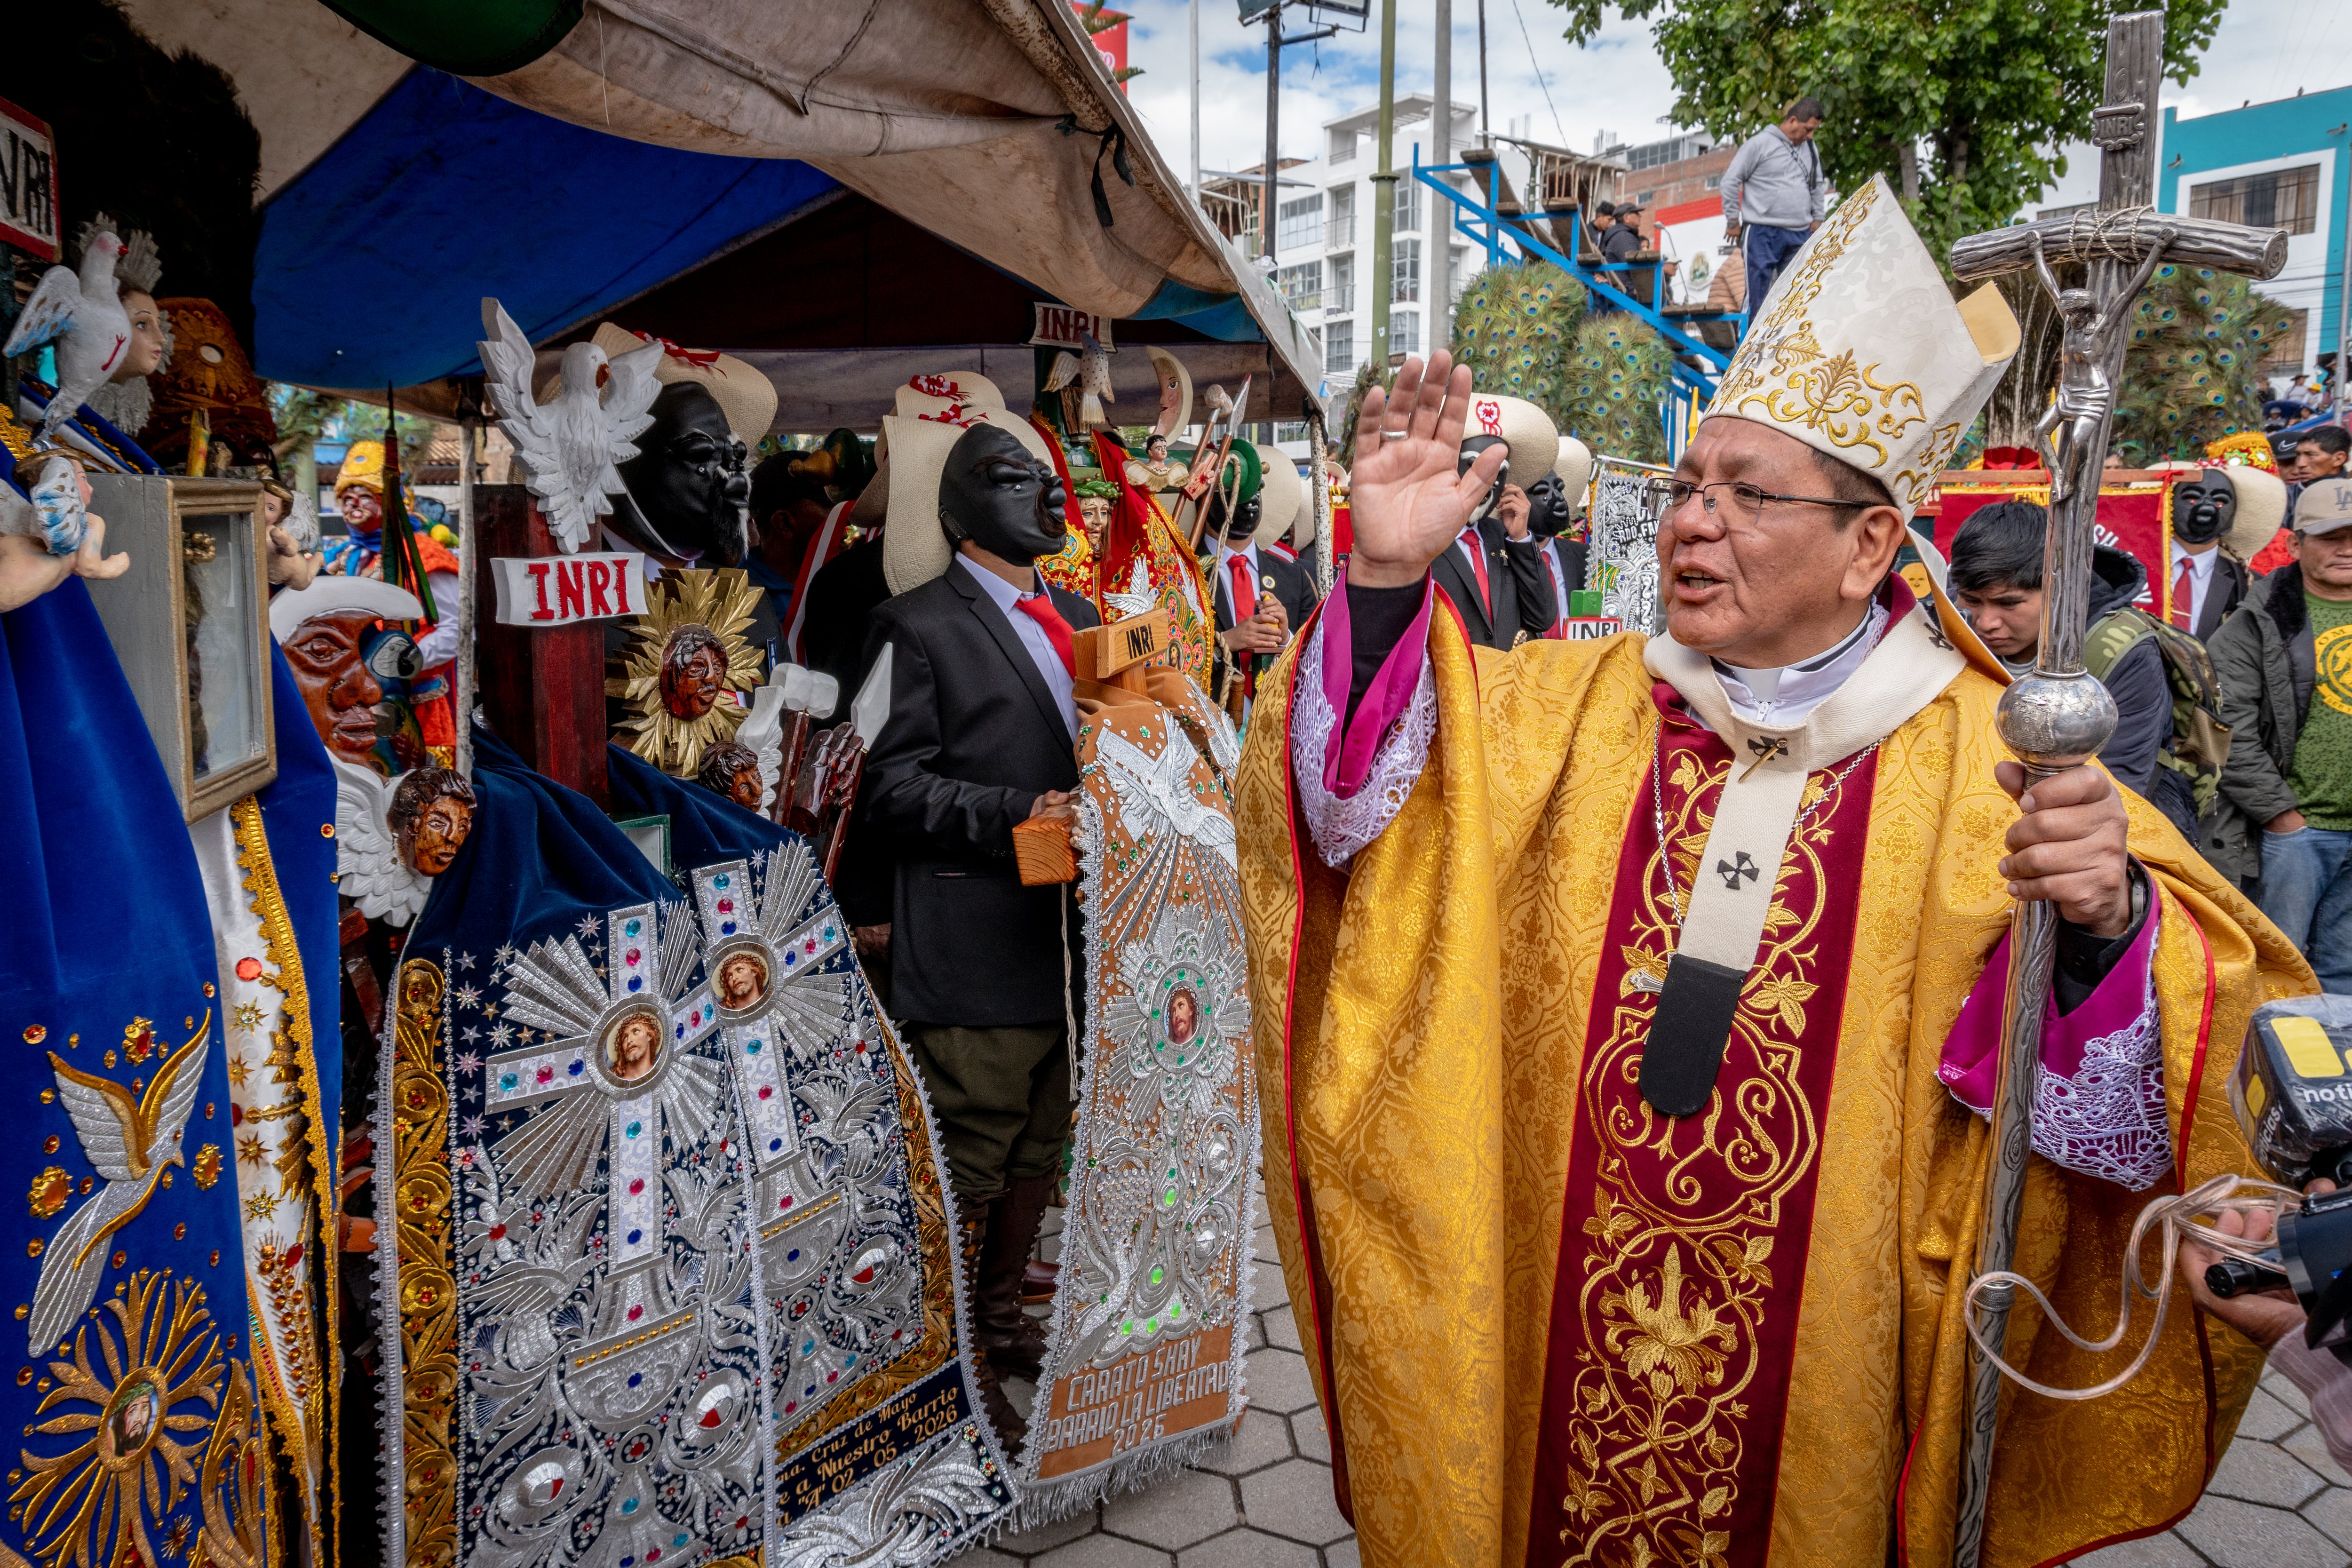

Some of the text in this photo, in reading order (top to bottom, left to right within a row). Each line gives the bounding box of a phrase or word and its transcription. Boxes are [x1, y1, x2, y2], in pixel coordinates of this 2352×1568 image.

[2100, 116, 2133, 139] INRI
[1041, 307, 1101, 345] INRI
[527, 558, 631, 620] INRI
[1126, 623, 1154, 660] INRI
[1573, 622, 1618, 639] INRI
[1067, 1335, 1201, 1412] CARATO SHAY
[811, 1434, 848, 1463] Cruz
[854, 1420, 873, 1438] de
[878, 1393, 917, 1424] Mayo
[1043, 1361, 1229, 1454] BARRIO LA LIBERTAD
[1112, 1413, 1167, 1457] 2026
[795, 1479, 811, 1496] a
[817, 1429, 893, 1481] Nuestro
[897, 1387, 959, 1432] Barrio
[832, 1467, 856, 1494] 02
[874, 1441, 897, 1467] 05
[914, 1404, 957, 1444] 2026
